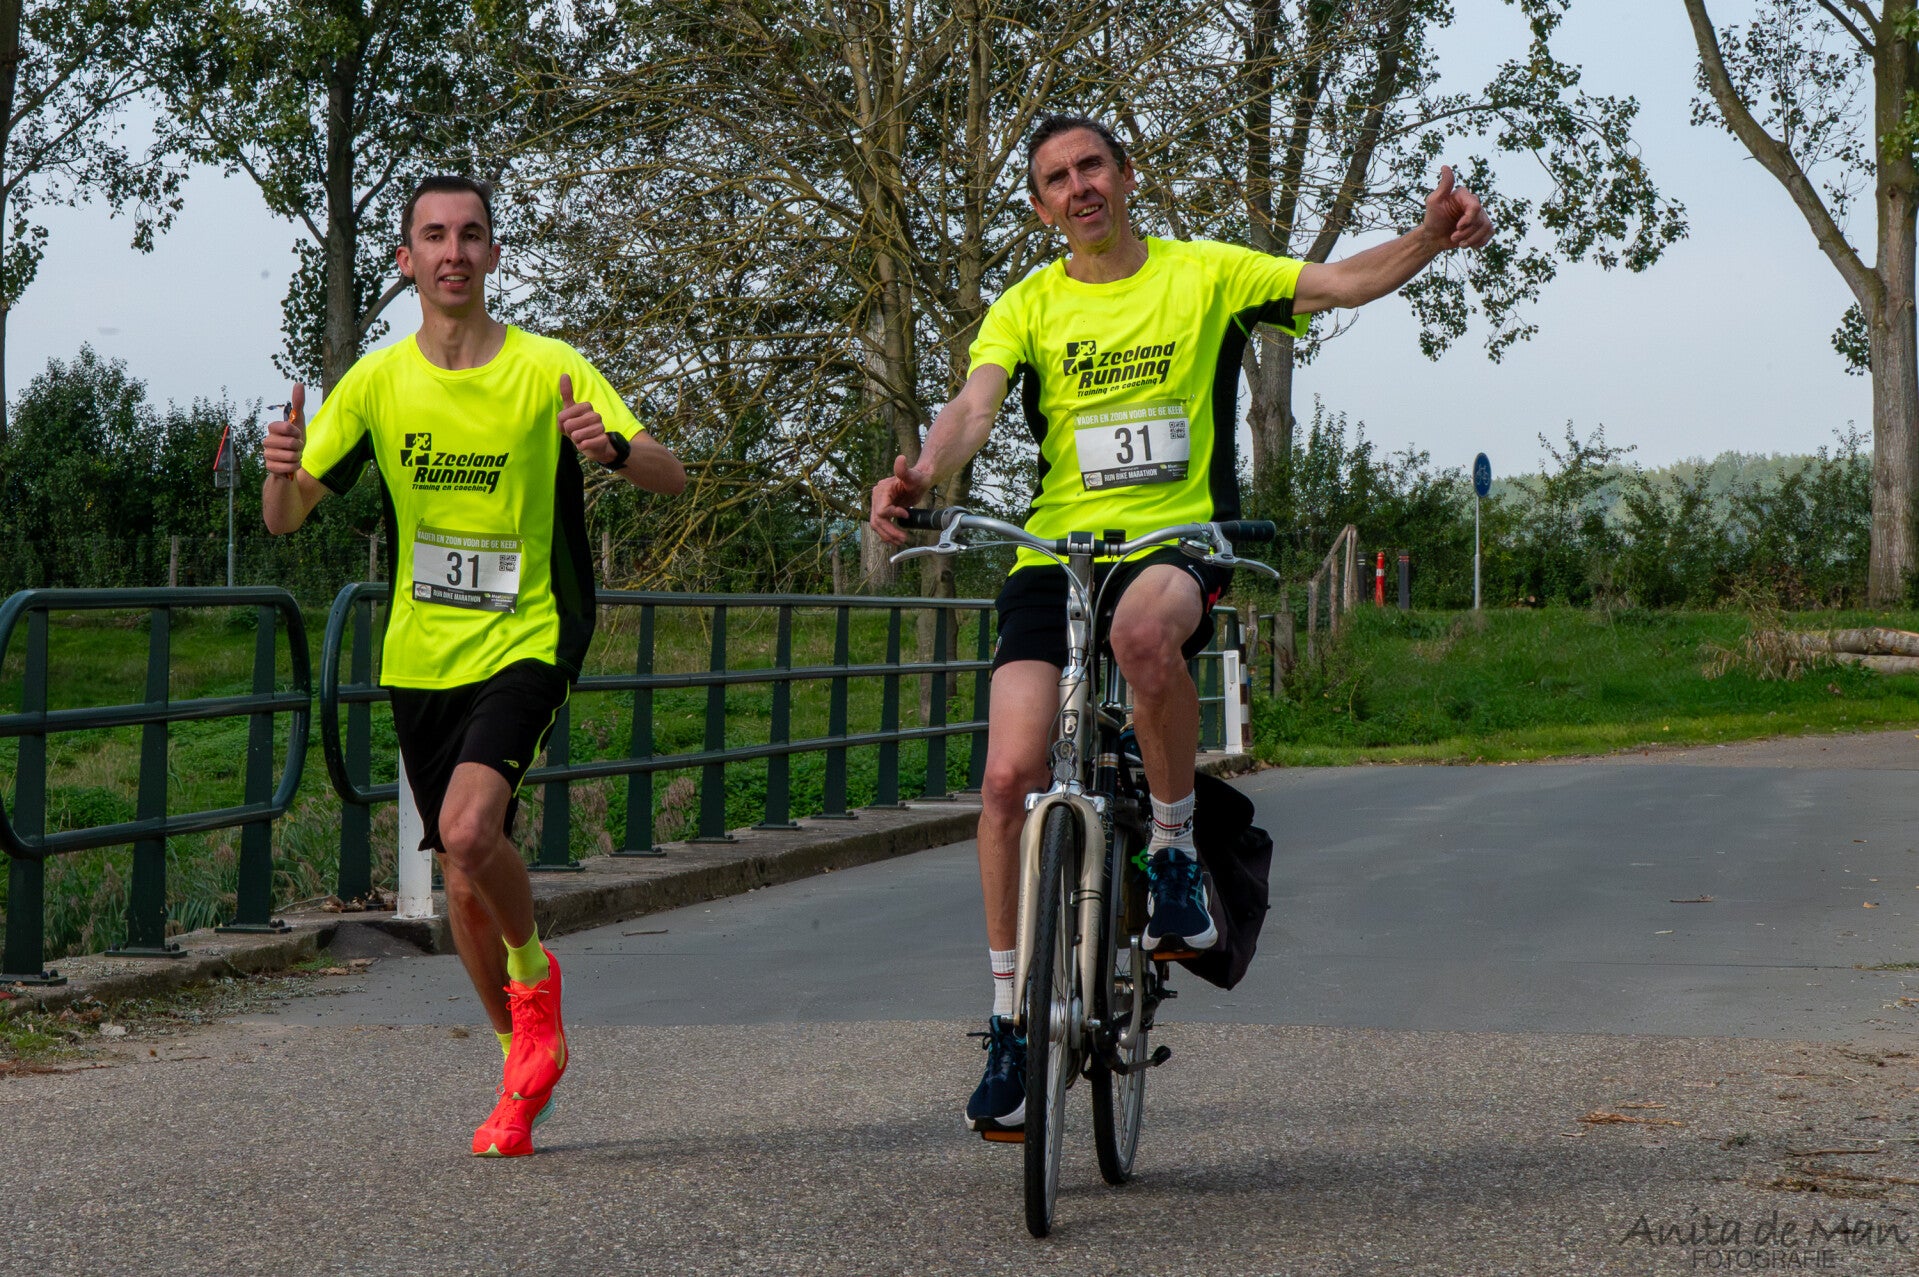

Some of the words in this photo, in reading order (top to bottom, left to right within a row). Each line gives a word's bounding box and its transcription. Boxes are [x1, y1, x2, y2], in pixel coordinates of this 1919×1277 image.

[1097, 341, 1176, 367] Zeeland
[1078, 359, 1171, 389] Running
[1077, 387, 1108, 397] Training
[1122, 378, 1158, 389] coaching
[1077, 415, 1098, 426] VADER
[1100, 413, 1109, 423] EN
[1110, 412, 1128, 422] ZOON
[1129, 409, 1147, 419] VOOR
[1148, 407, 1157, 417] DE
[1167, 405, 1183, 415] KEER
[1114, 424, 1152, 465] 31
[432, 452, 509, 467] Zeeland
[413, 466, 501, 494] Running
[1104, 473, 1116, 482] RUN
[1116, 471, 1128, 480] BIKE
[1128, 468, 1158, 479] MARATHON
[417, 531, 435, 542] VADER
[436, 534, 444, 544] EN
[445, 535, 462, 545] ZOON
[463, 538, 480, 547] VOOR
[481, 539, 489, 548] DE
[500, 540, 517, 549] KEER
[446, 551, 480, 588] 31
[454, 592, 481, 603] MARATHON
